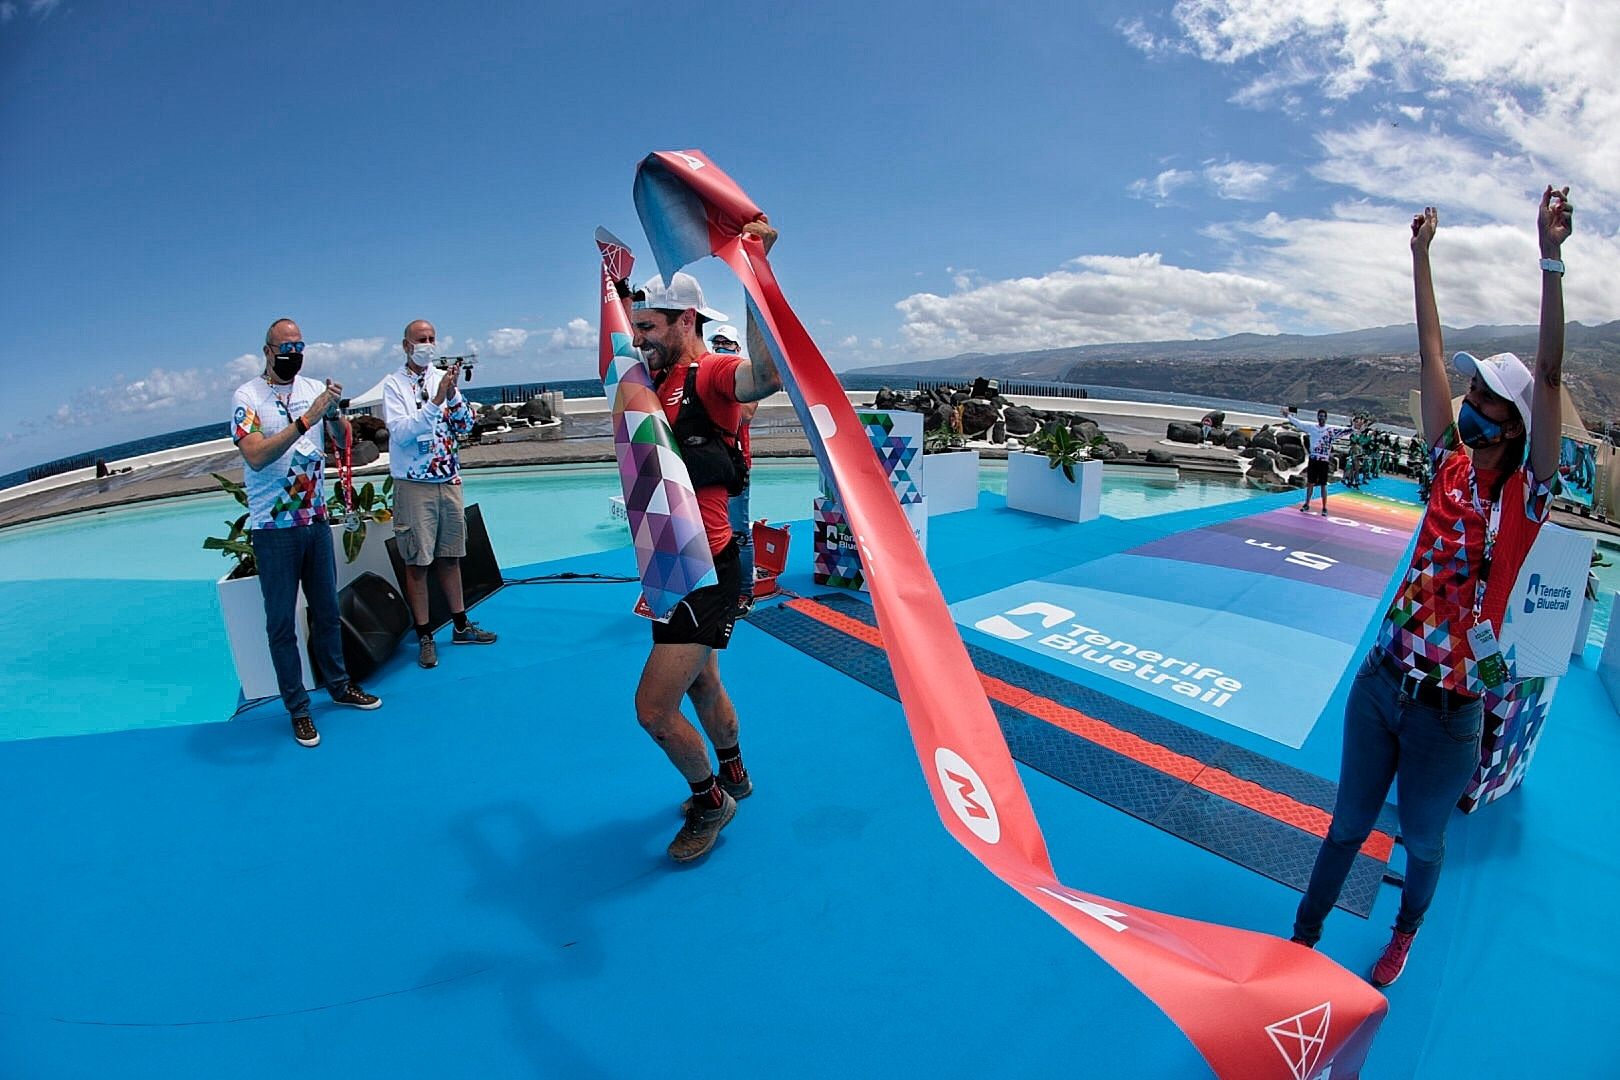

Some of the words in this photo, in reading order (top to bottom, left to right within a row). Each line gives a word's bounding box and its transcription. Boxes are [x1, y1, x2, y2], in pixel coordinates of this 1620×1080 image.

[1536, 597, 1570, 611] Bluetrail
[1540, 584, 1571, 599] Tenerife
[1038, 634, 1232, 707] Bluetrail
[1068, 623, 1242, 692] Tenerife
